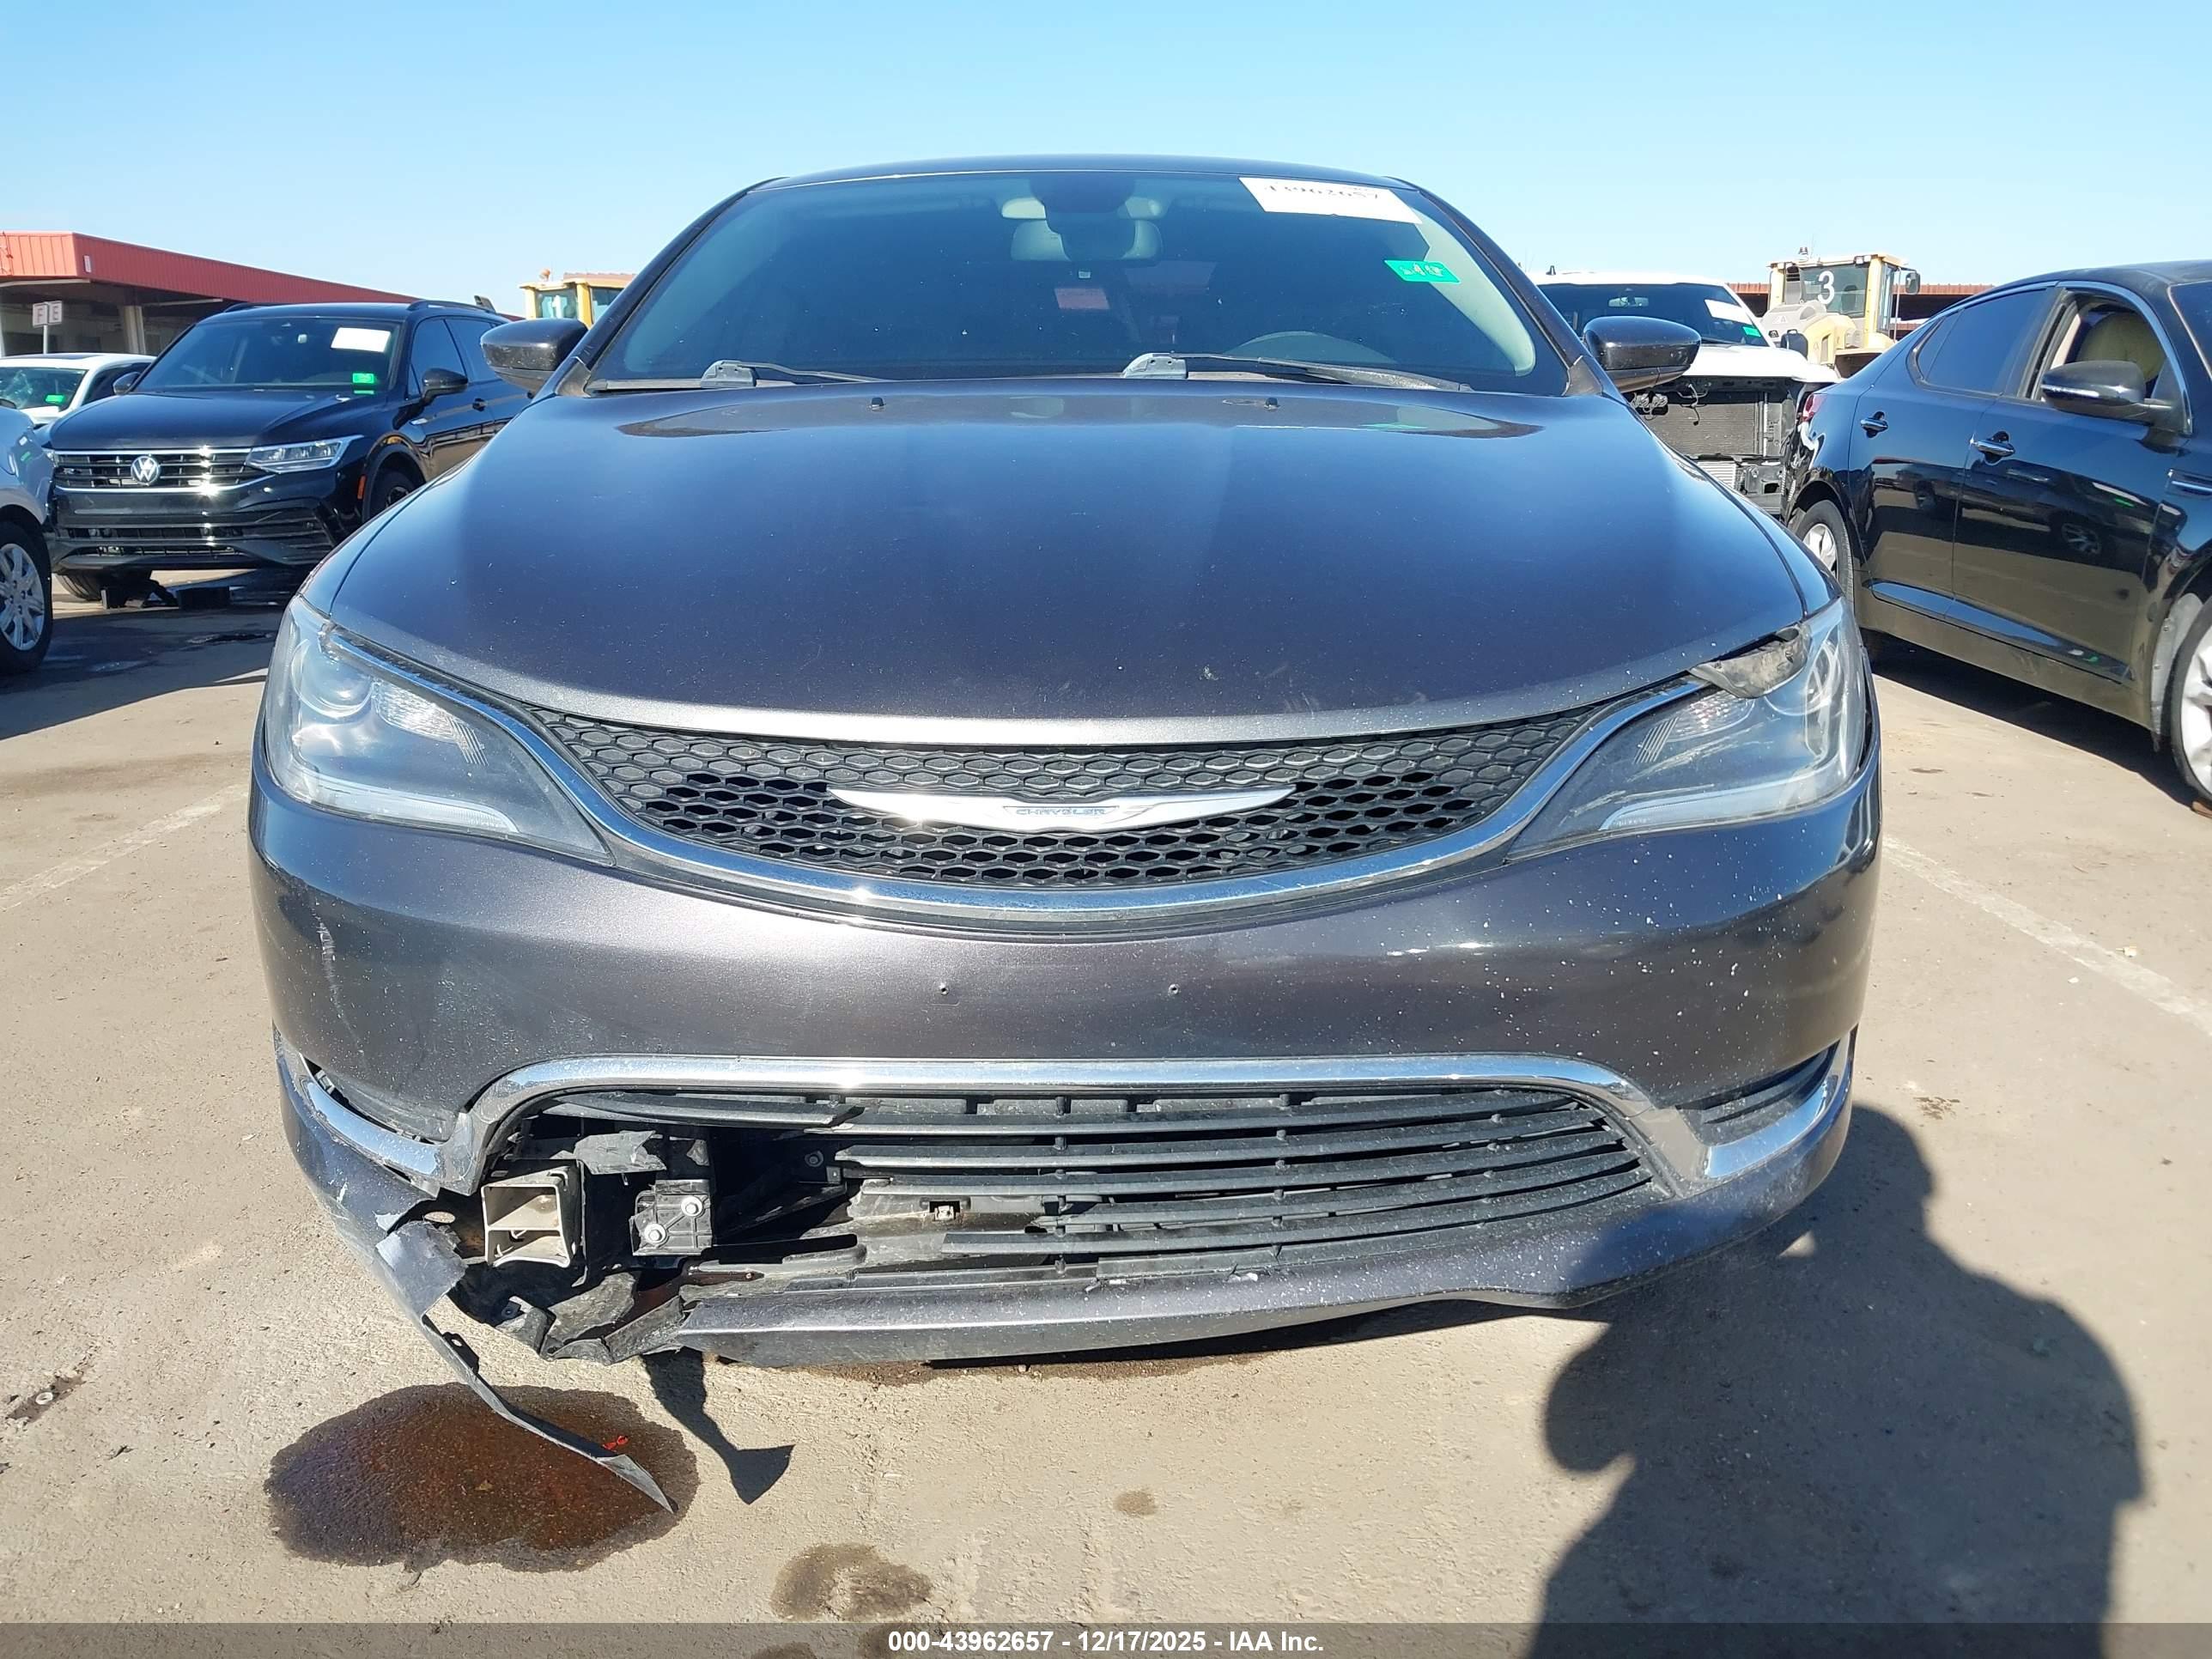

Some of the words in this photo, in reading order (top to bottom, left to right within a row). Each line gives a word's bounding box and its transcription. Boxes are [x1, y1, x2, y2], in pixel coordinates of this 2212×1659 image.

[1817, 270, 1835, 305] 3
[37, 307, 43, 324] F
[52, 306, 58, 321] E
